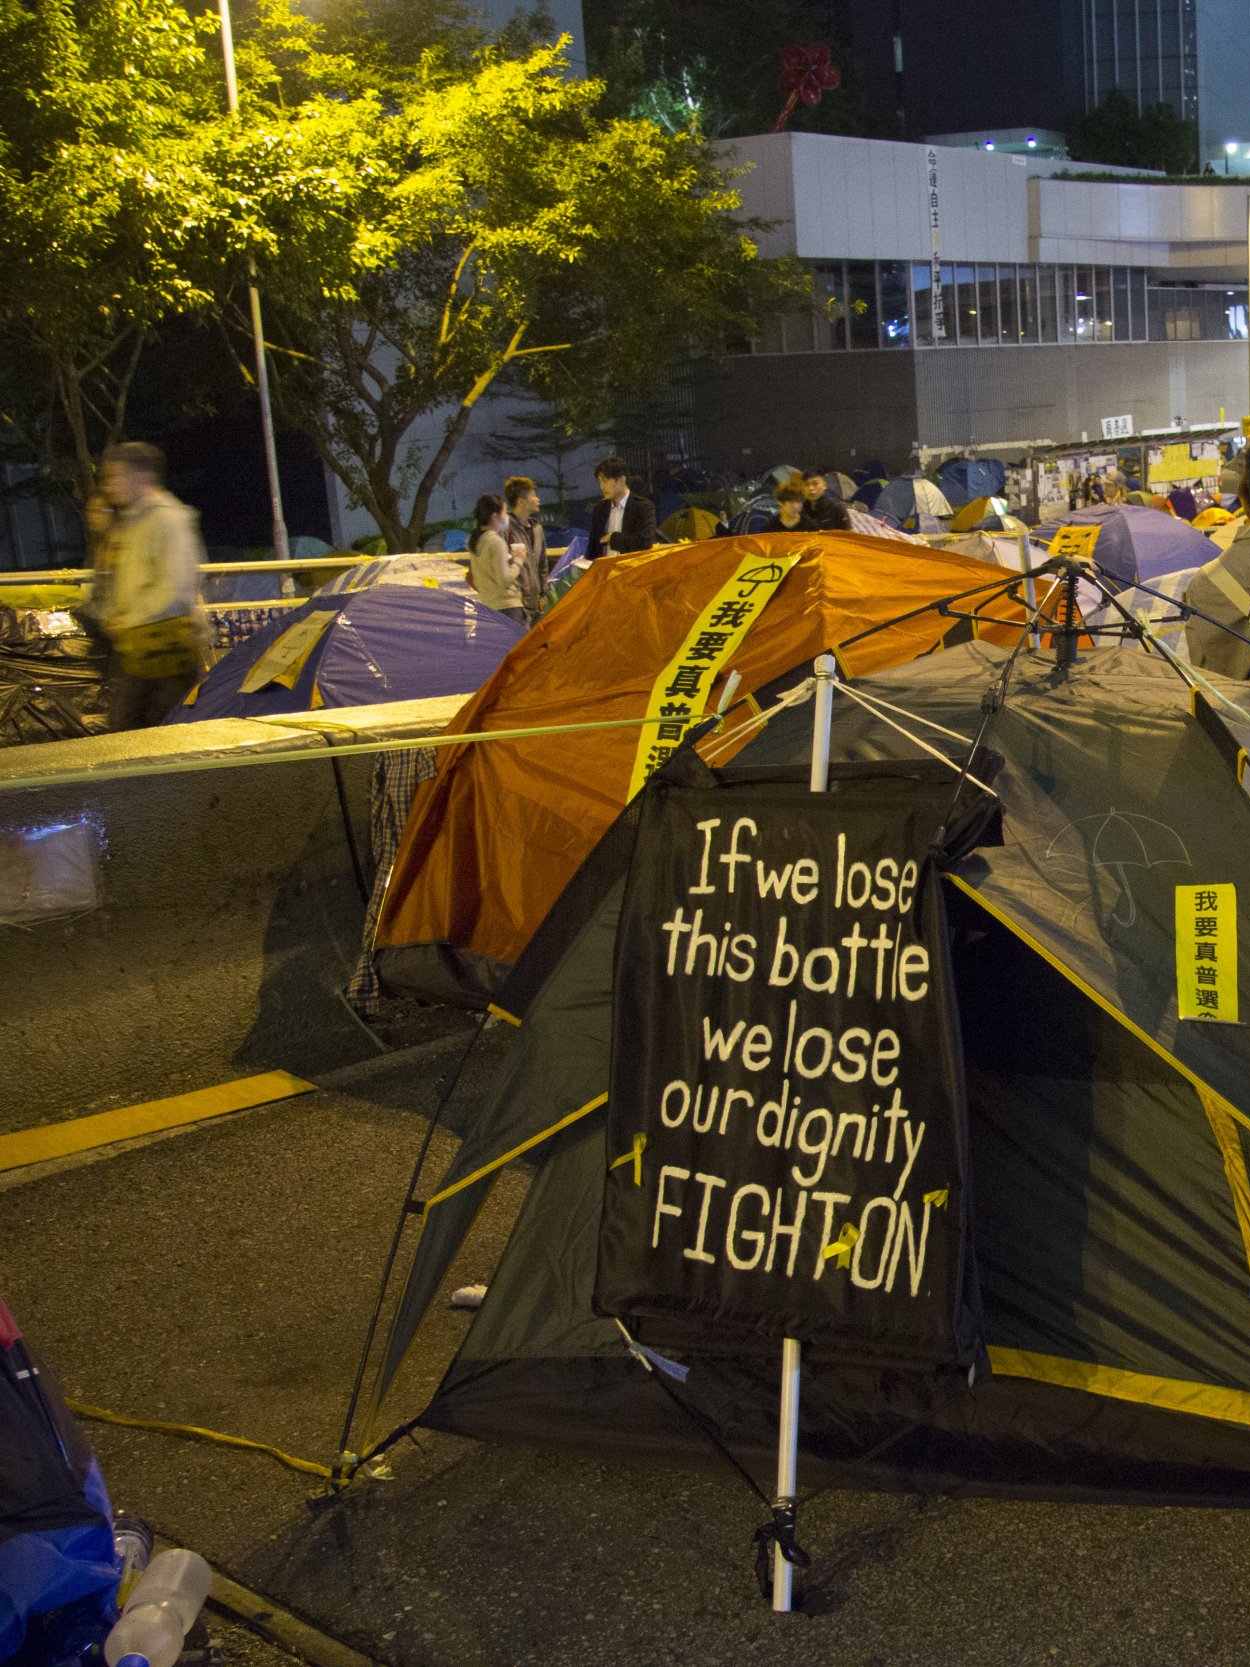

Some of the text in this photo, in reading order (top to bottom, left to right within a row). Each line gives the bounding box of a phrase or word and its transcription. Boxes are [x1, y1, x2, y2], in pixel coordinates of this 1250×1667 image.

[689, 817, 918, 912] If we lose
[662, 908, 929, 1001] this battle
[1194, 890, 1219, 1010] 我要真普選
[703, 1000, 900, 1087] we lose
[661, 1079, 925, 1200] our dignity
[652, 1165, 931, 1297] FIGHT ON
